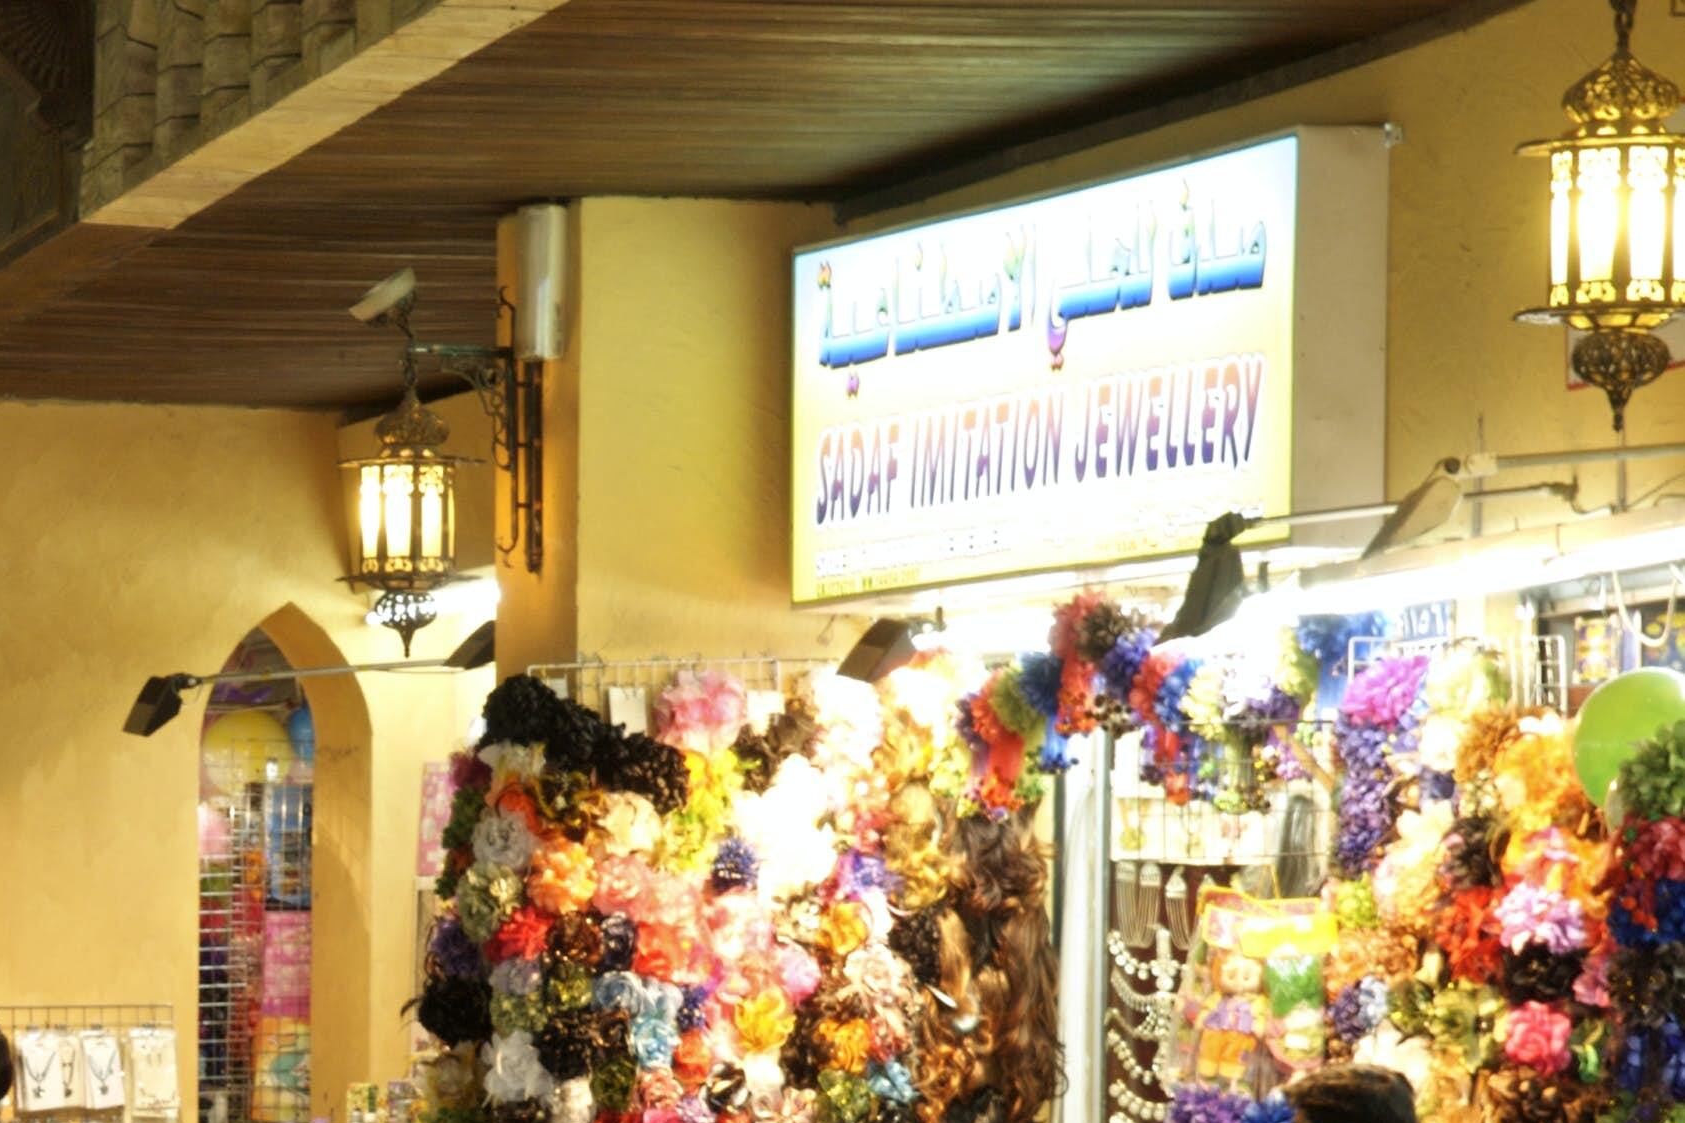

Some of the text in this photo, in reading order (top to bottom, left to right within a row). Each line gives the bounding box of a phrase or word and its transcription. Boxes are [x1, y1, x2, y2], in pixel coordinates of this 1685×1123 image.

[1047, 201, 1156, 370] للحلي
[1167, 179, 1266, 300] صدف
[816, 362, 1263, 525] SADAF IMITATION JEWELLERY
